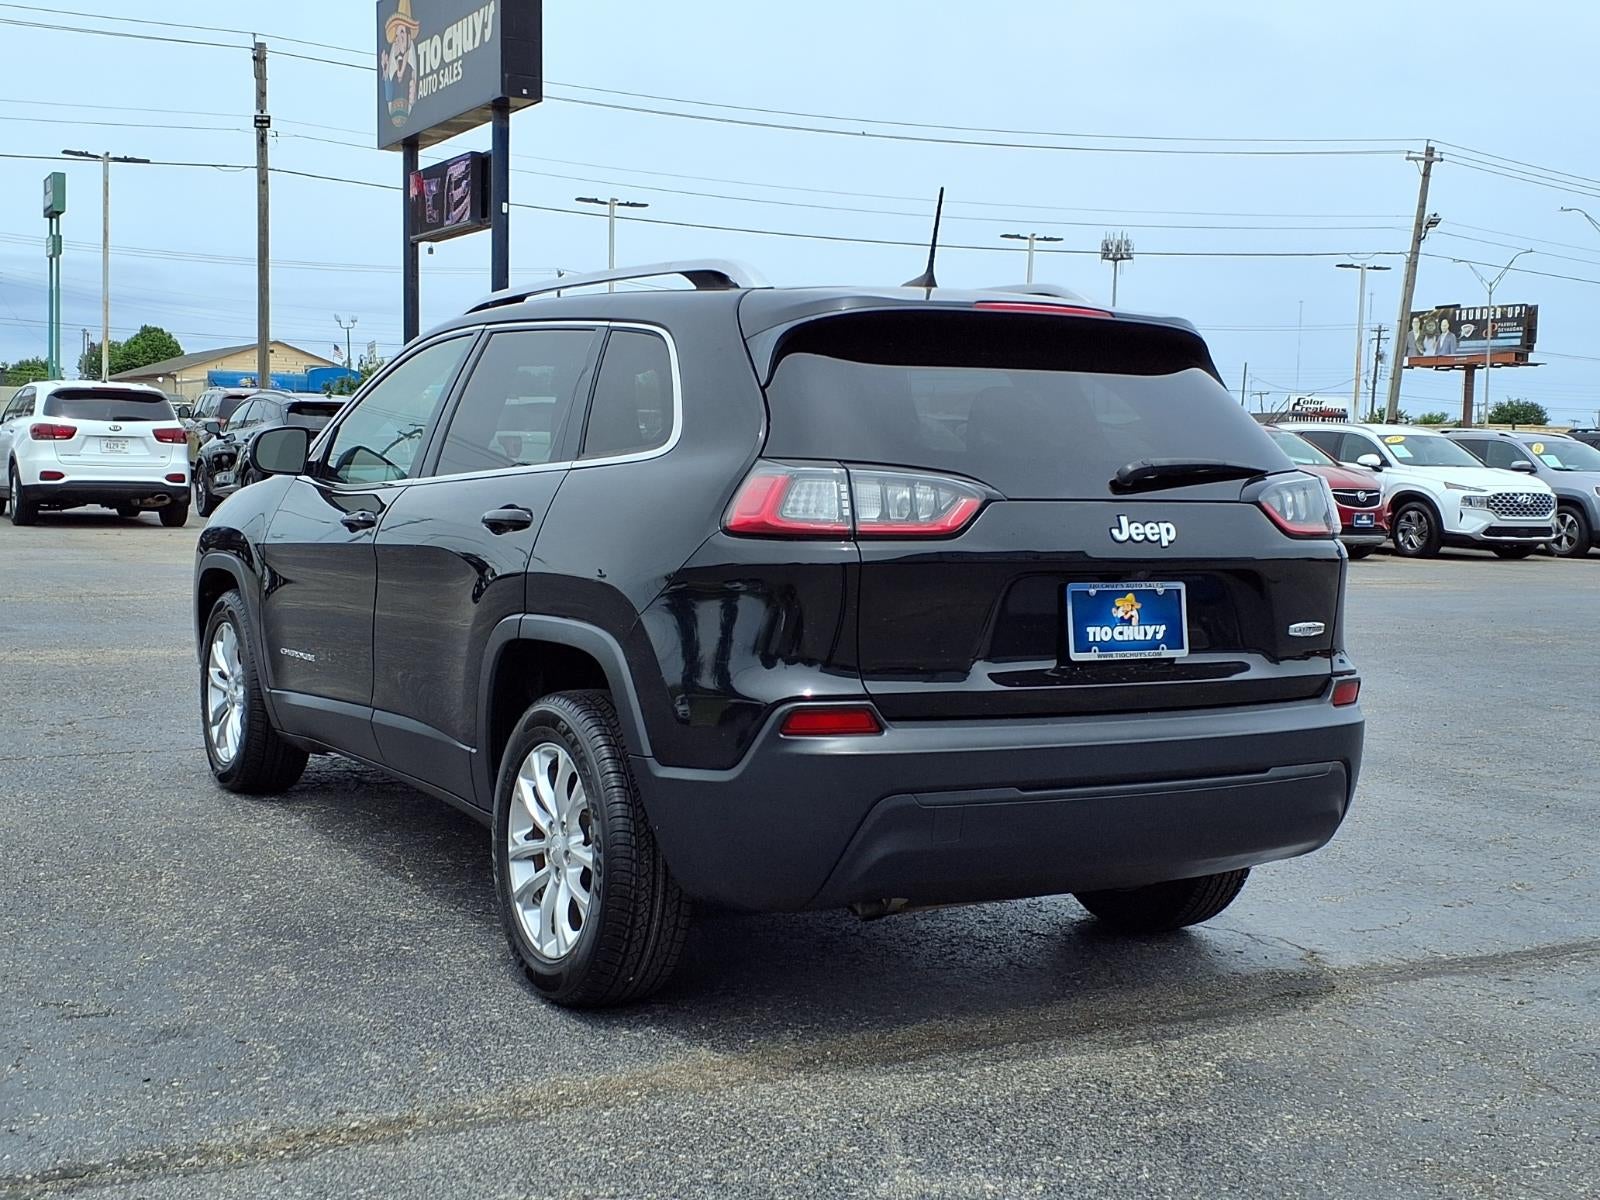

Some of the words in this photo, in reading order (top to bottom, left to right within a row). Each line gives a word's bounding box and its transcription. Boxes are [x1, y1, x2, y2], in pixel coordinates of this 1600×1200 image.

[417, 35, 441, 77] TIO
[442, 0, 495, 63] CHUY'S
[418, 70, 438, 100] AUTO
[438, 61, 463, 90] SALES
[1456, 308, 1501, 321] THUNDER
[1507, 305, 1526, 318] UP!
[1292, 402, 1347, 413] Creations
[1295, 397, 1324, 406] Color
[1110, 514, 1177, 548] Jeep
[1087, 627, 1113, 642] TIO
[1113, 624, 1166, 641] CHUY'S
